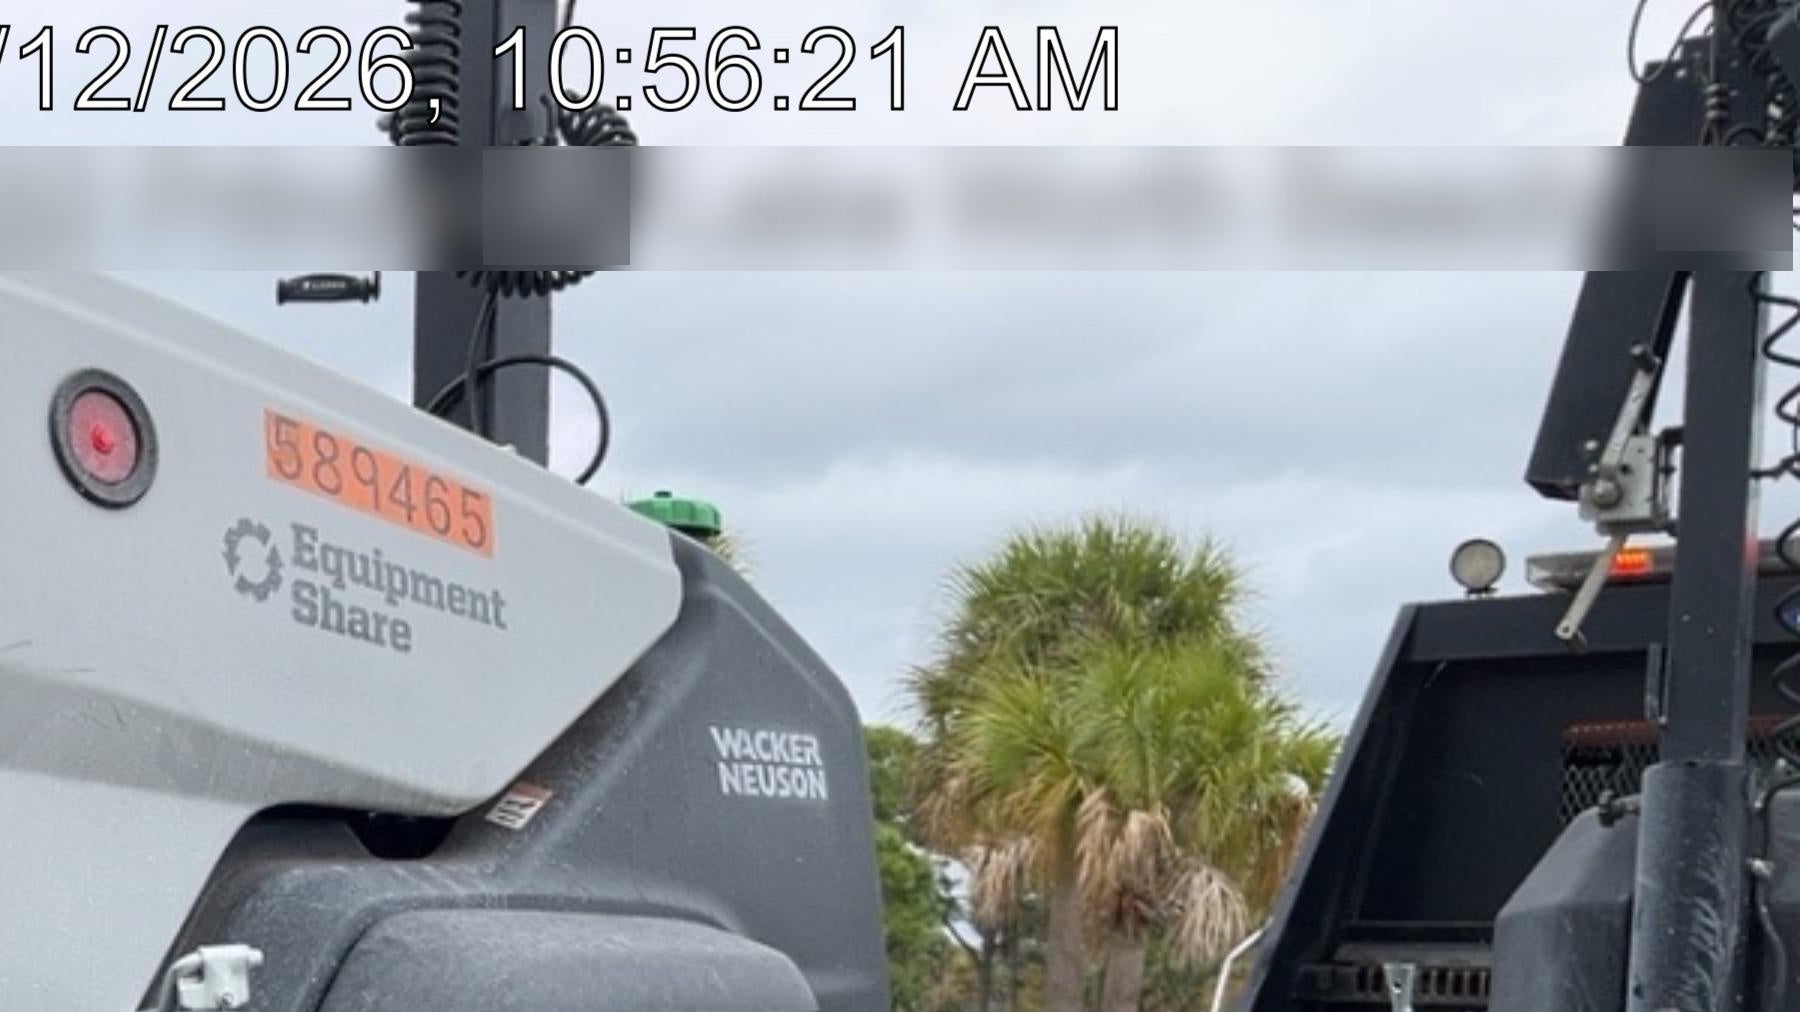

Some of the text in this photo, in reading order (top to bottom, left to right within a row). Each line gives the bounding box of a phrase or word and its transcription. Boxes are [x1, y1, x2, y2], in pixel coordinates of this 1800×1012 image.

[272, 412, 487, 549] 589465
[291, 522, 507, 629] Equipment
[291, 578, 412, 653] Share
[709, 725, 822, 766] WACKER
[719, 760, 828, 800] NEUSON
